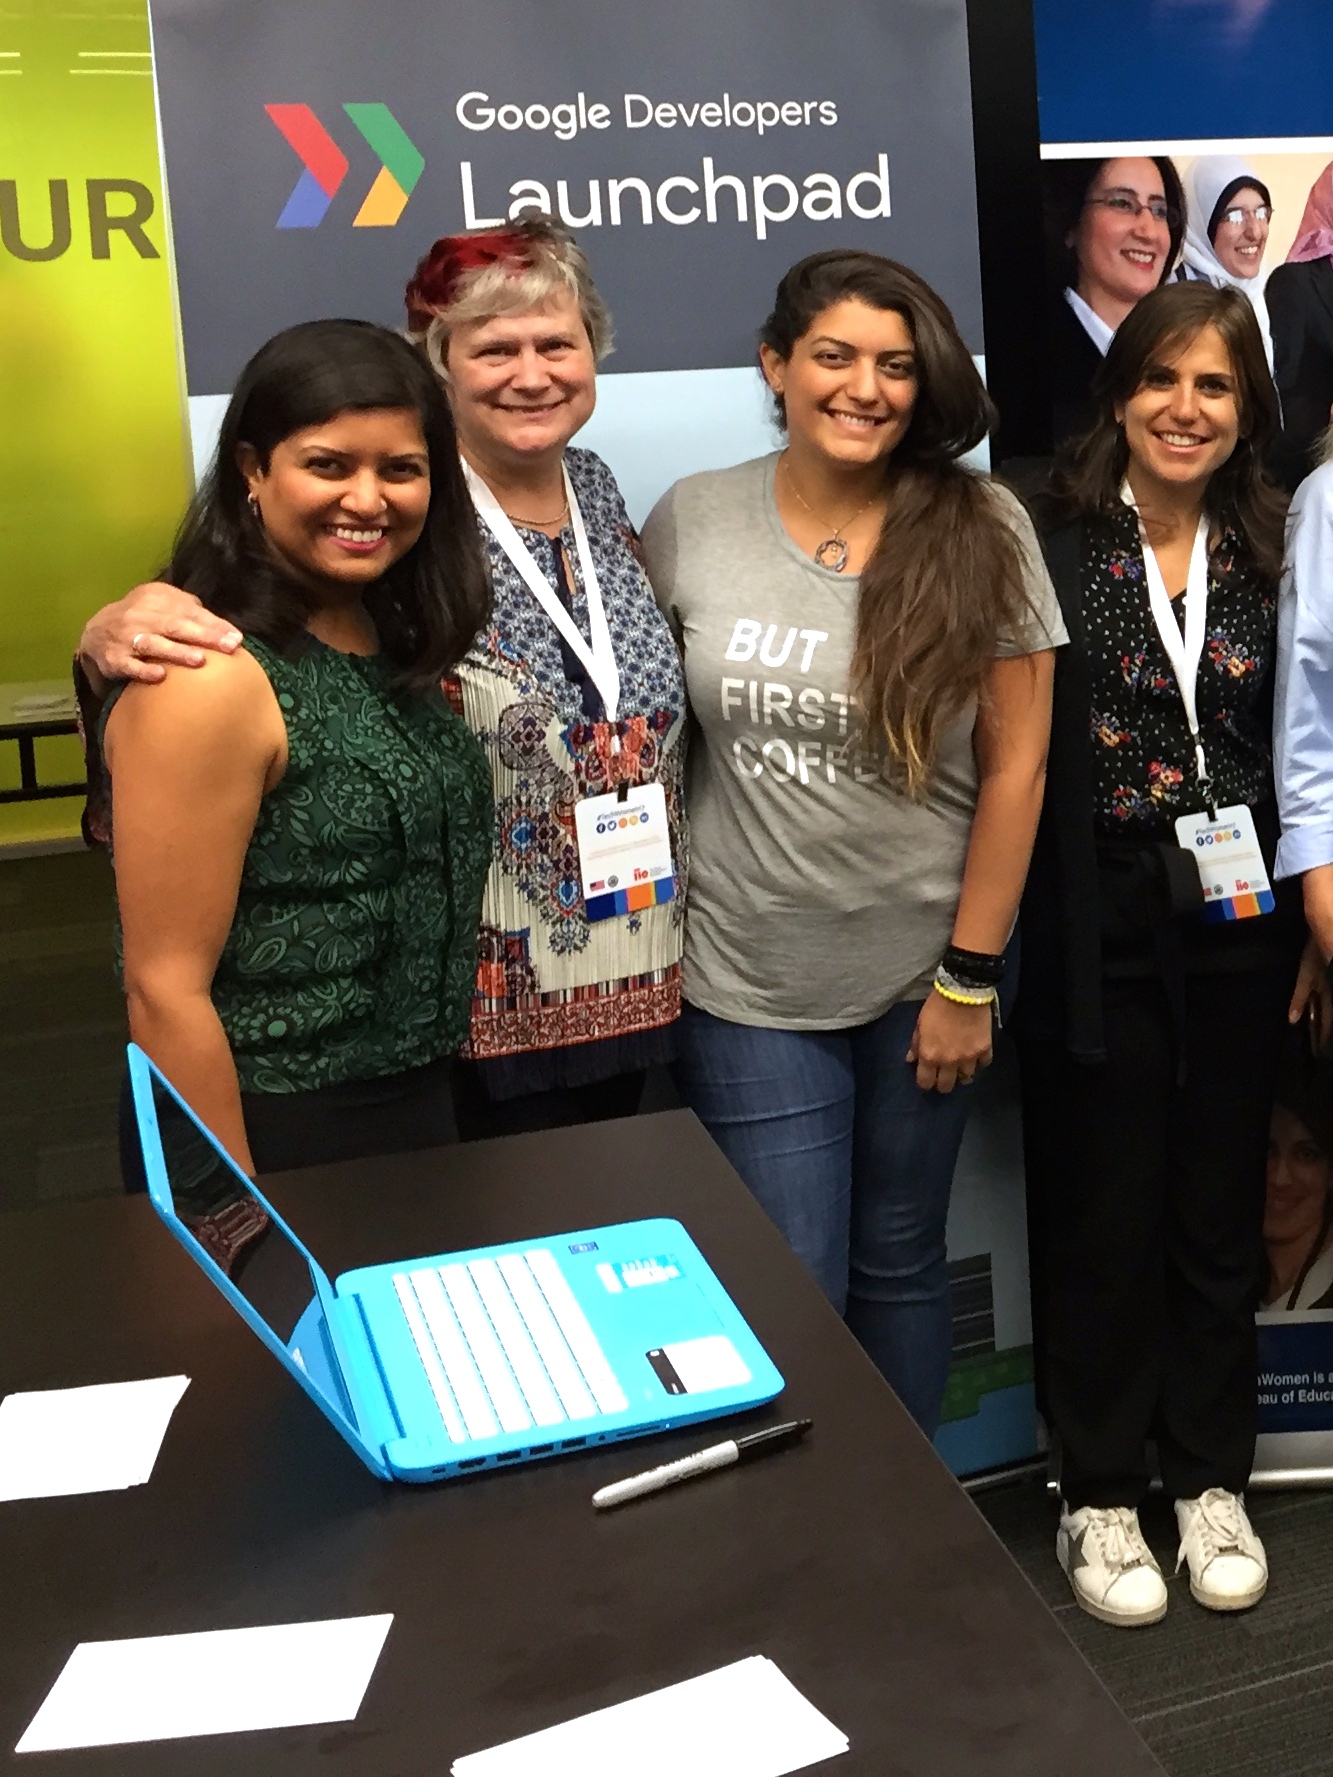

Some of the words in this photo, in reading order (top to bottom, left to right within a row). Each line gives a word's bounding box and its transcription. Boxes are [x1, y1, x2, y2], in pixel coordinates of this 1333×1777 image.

[456, 91, 611, 140] Google
[625, 93, 838, 136] Developers
[0, 178, 161, 262] UR
[460, 154, 892, 241] Launchpad
[725, 618, 829, 674] BUT
[721, 677, 858, 737] FIRST
[1281, 1390, 1295, 1403] of
[1313, 1371, 1325, 1384] is
